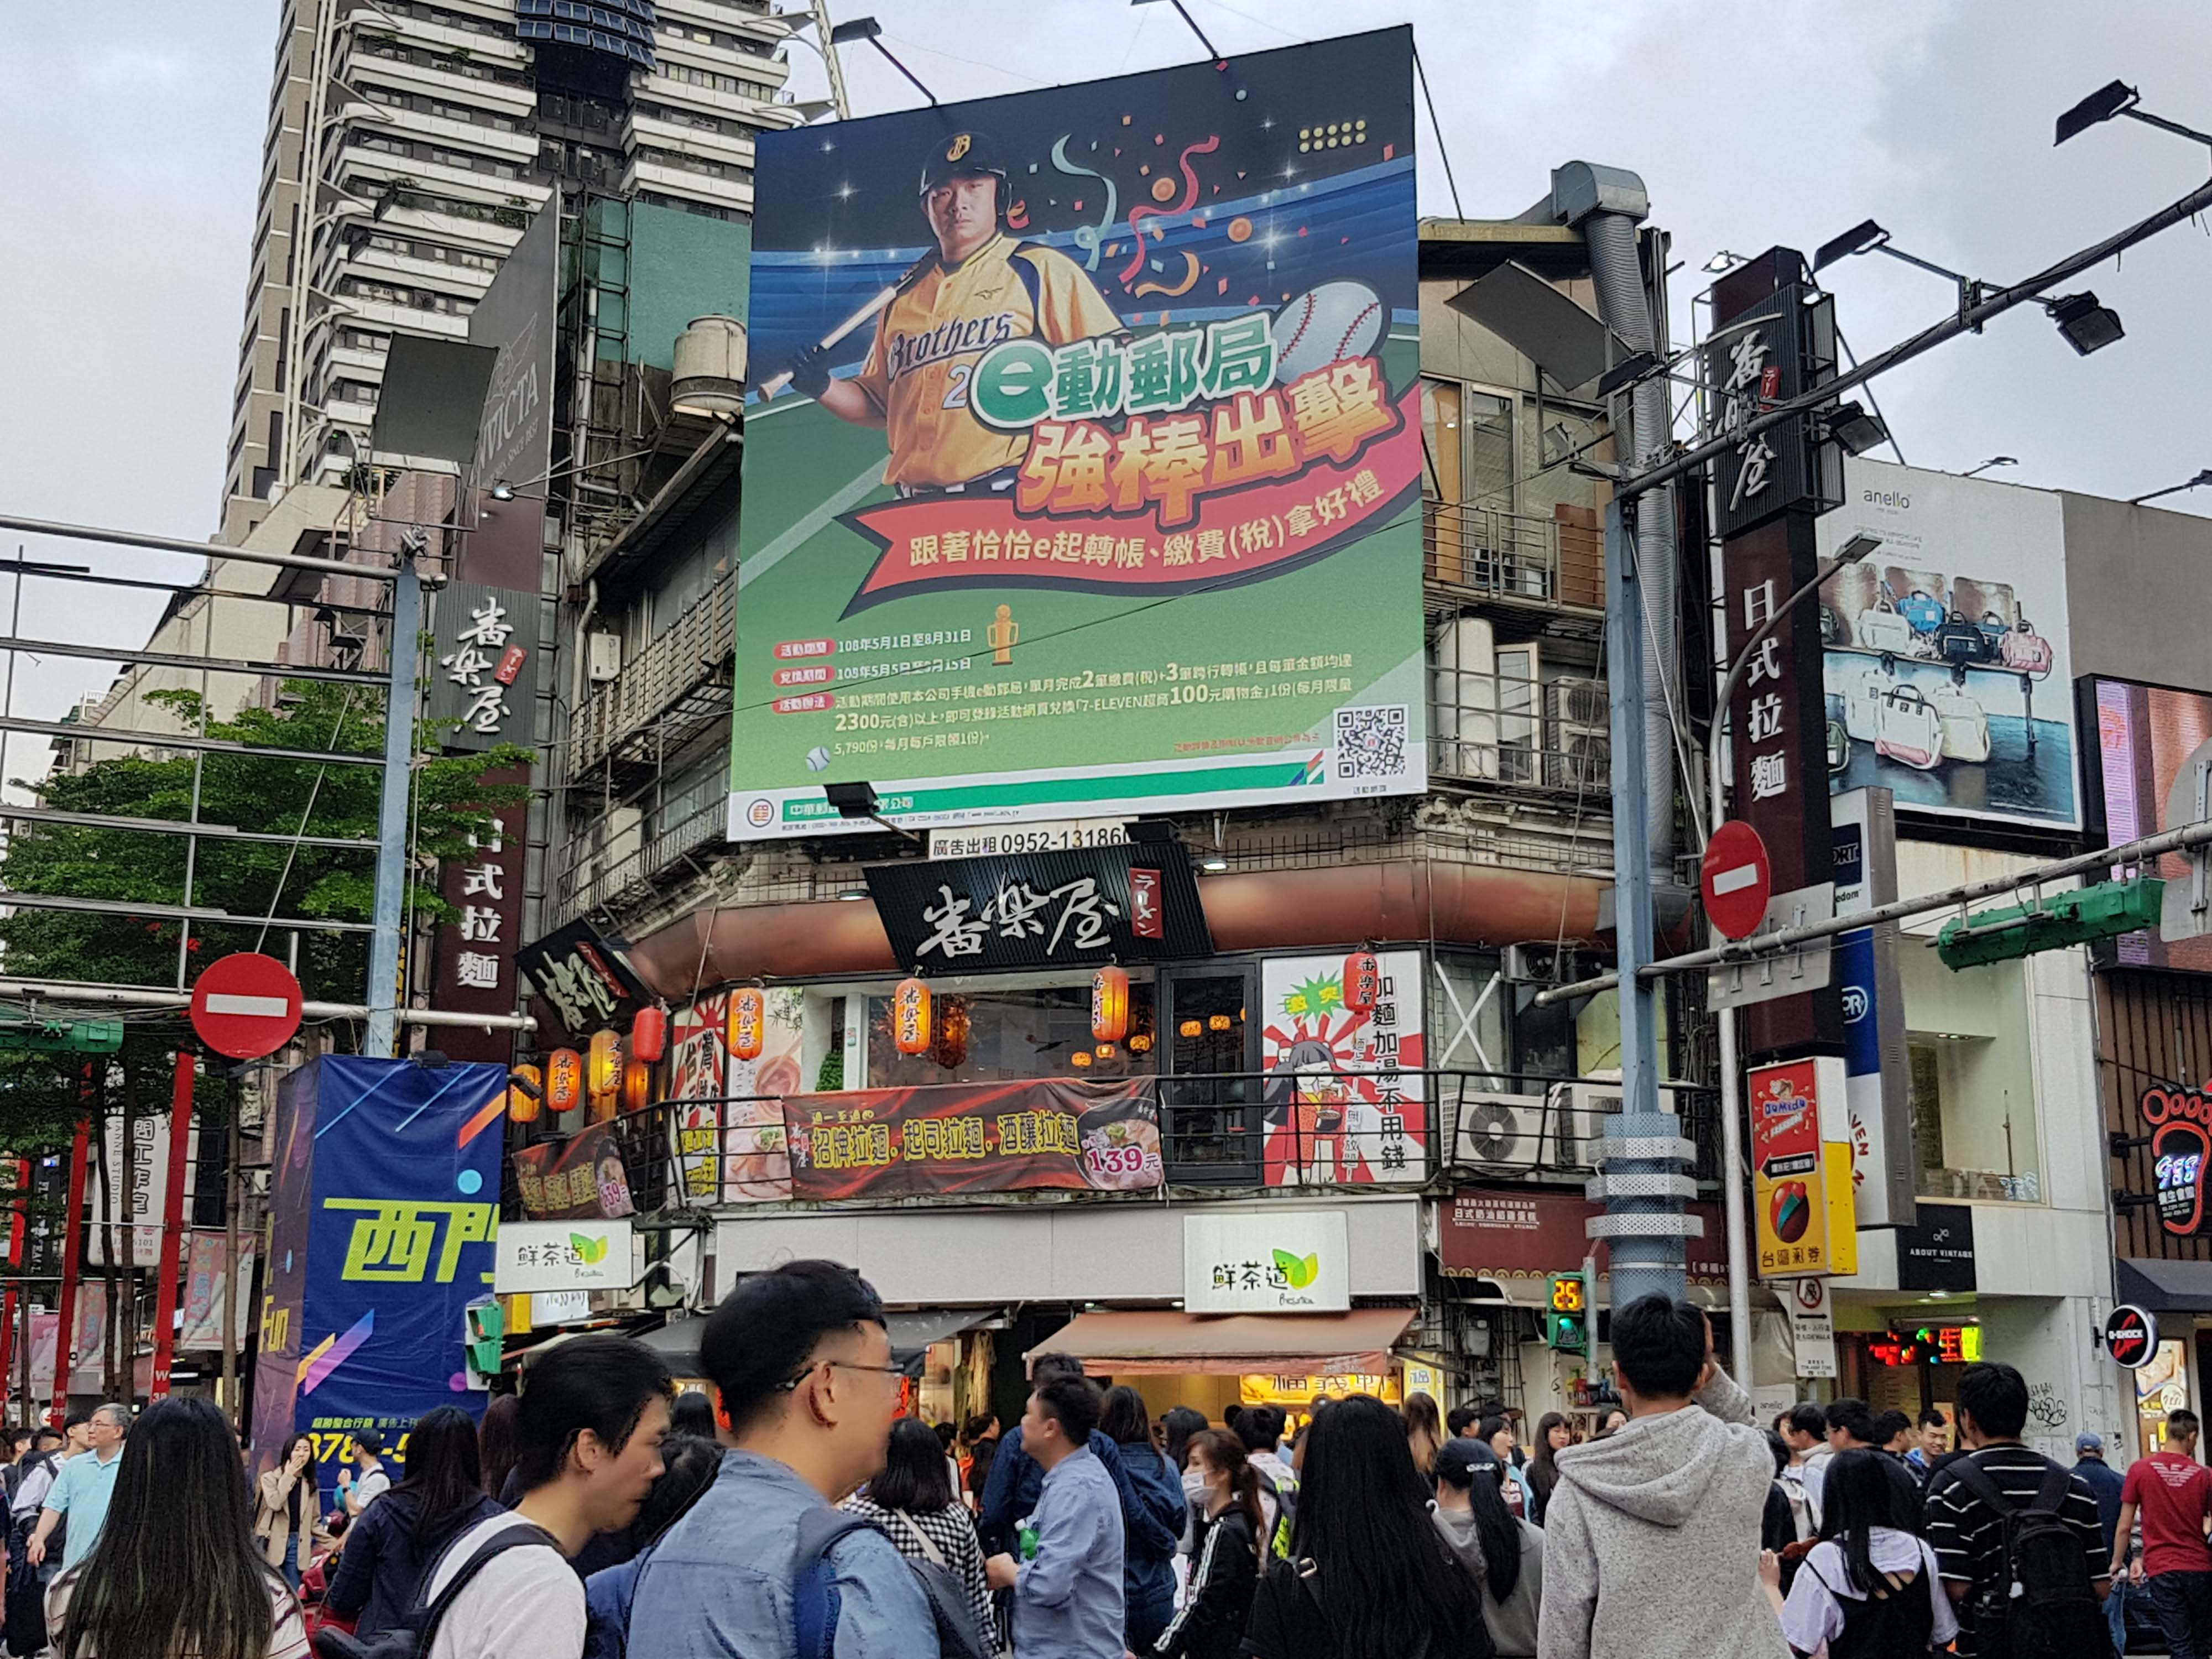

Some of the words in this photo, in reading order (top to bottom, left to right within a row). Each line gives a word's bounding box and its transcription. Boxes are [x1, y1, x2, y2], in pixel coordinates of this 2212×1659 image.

[887, 314, 1014, 383] Brothers
[972, 313, 1277, 428] e動郵局
[941, 364, 972, 410] 2
[1022, 362, 1391, 521] 強棒出擊
[1714, 329, 1777, 512] 番屋
[1863, 490, 1910, 509] anello
[1744, 578, 1787, 803] 日式拉麵
[934, 836, 997, 855] 廣告出租
[813, 1124, 889, 1168] 招牌拉麵
[903, 1116, 986, 1161] 起司拉麵
[517, 1241, 583, 1267] 鮮茶道
[1762, 1246, 1821, 1267] 台灣彩券
[1910, 1248, 1937, 1256] ABOUT
[1939, 1250, 1973, 1258] VINTAGE
[1212, 1260, 1288, 1291] 鮮茶道
[1553, 1280, 1582, 1311] 25
[259, 1295, 290, 1353] Fun
